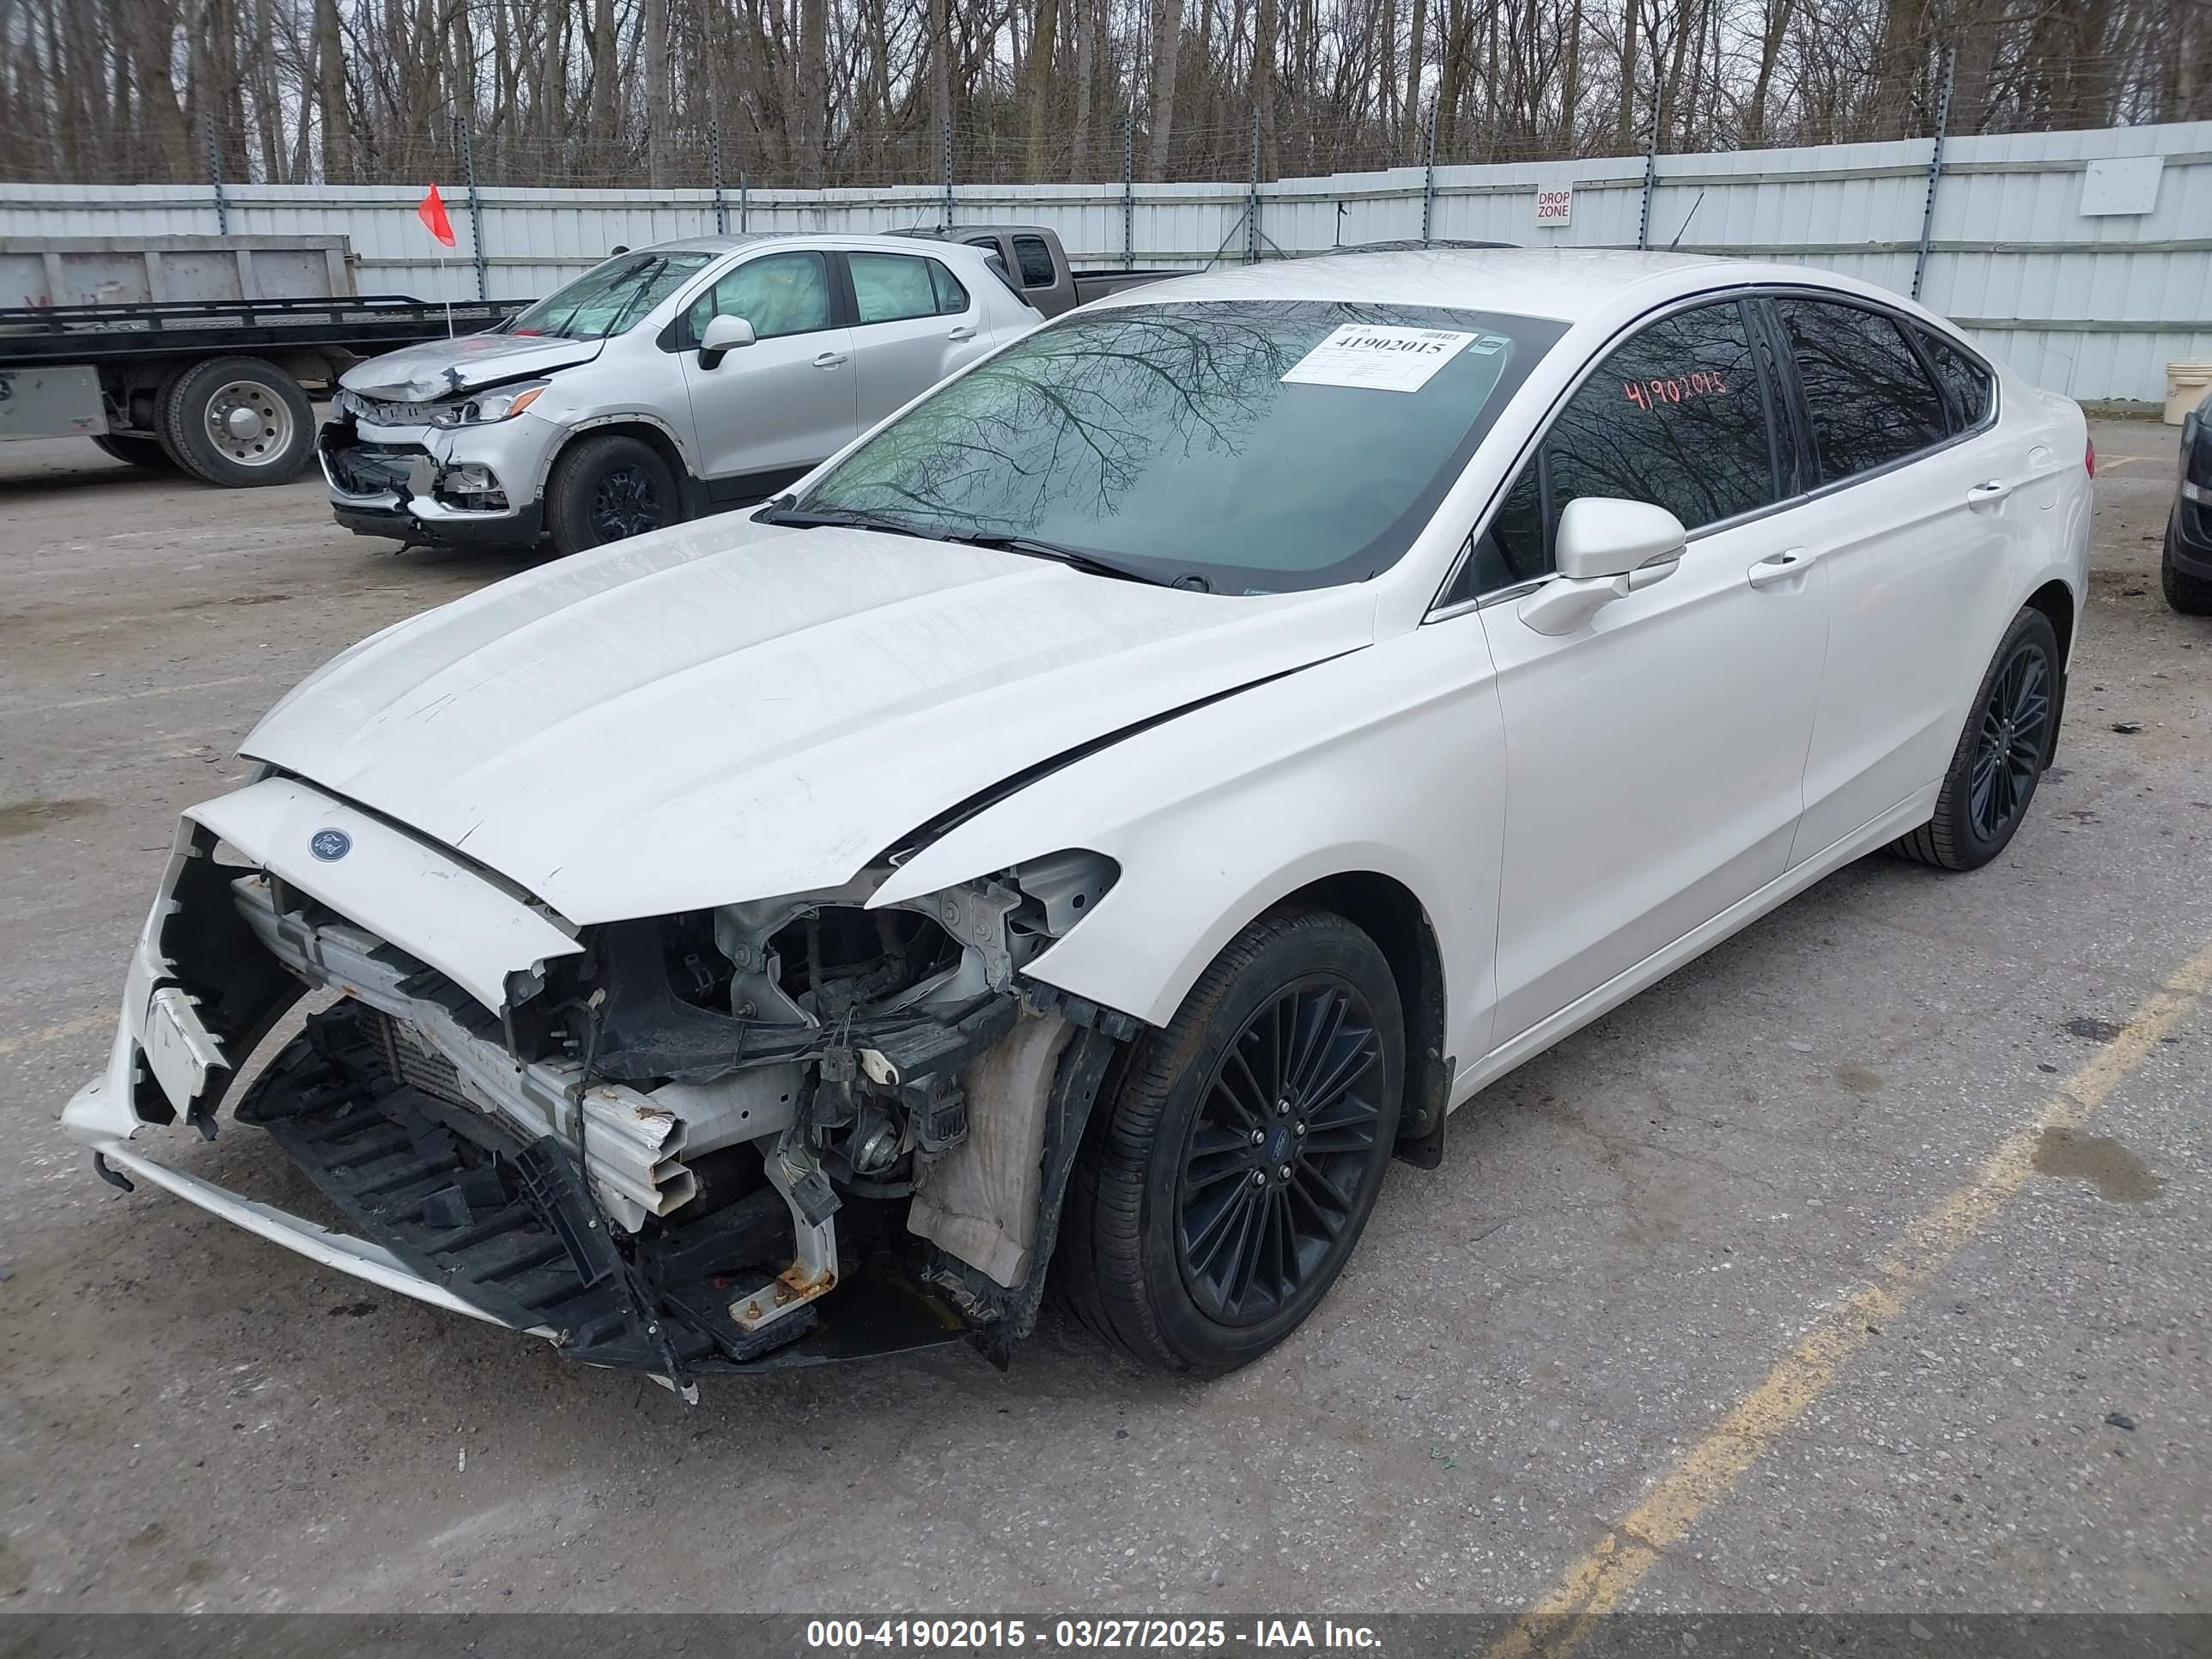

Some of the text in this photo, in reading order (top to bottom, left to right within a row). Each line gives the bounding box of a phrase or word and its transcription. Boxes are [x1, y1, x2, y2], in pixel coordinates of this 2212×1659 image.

[1539, 191, 1571, 204] DROP
[1538, 205, 1569, 217] ZONE
[1335, 336, 1448, 355] 41902015
[1623, 371, 1726, 410] 41902015
[314, 833, 342, 855] Ford
